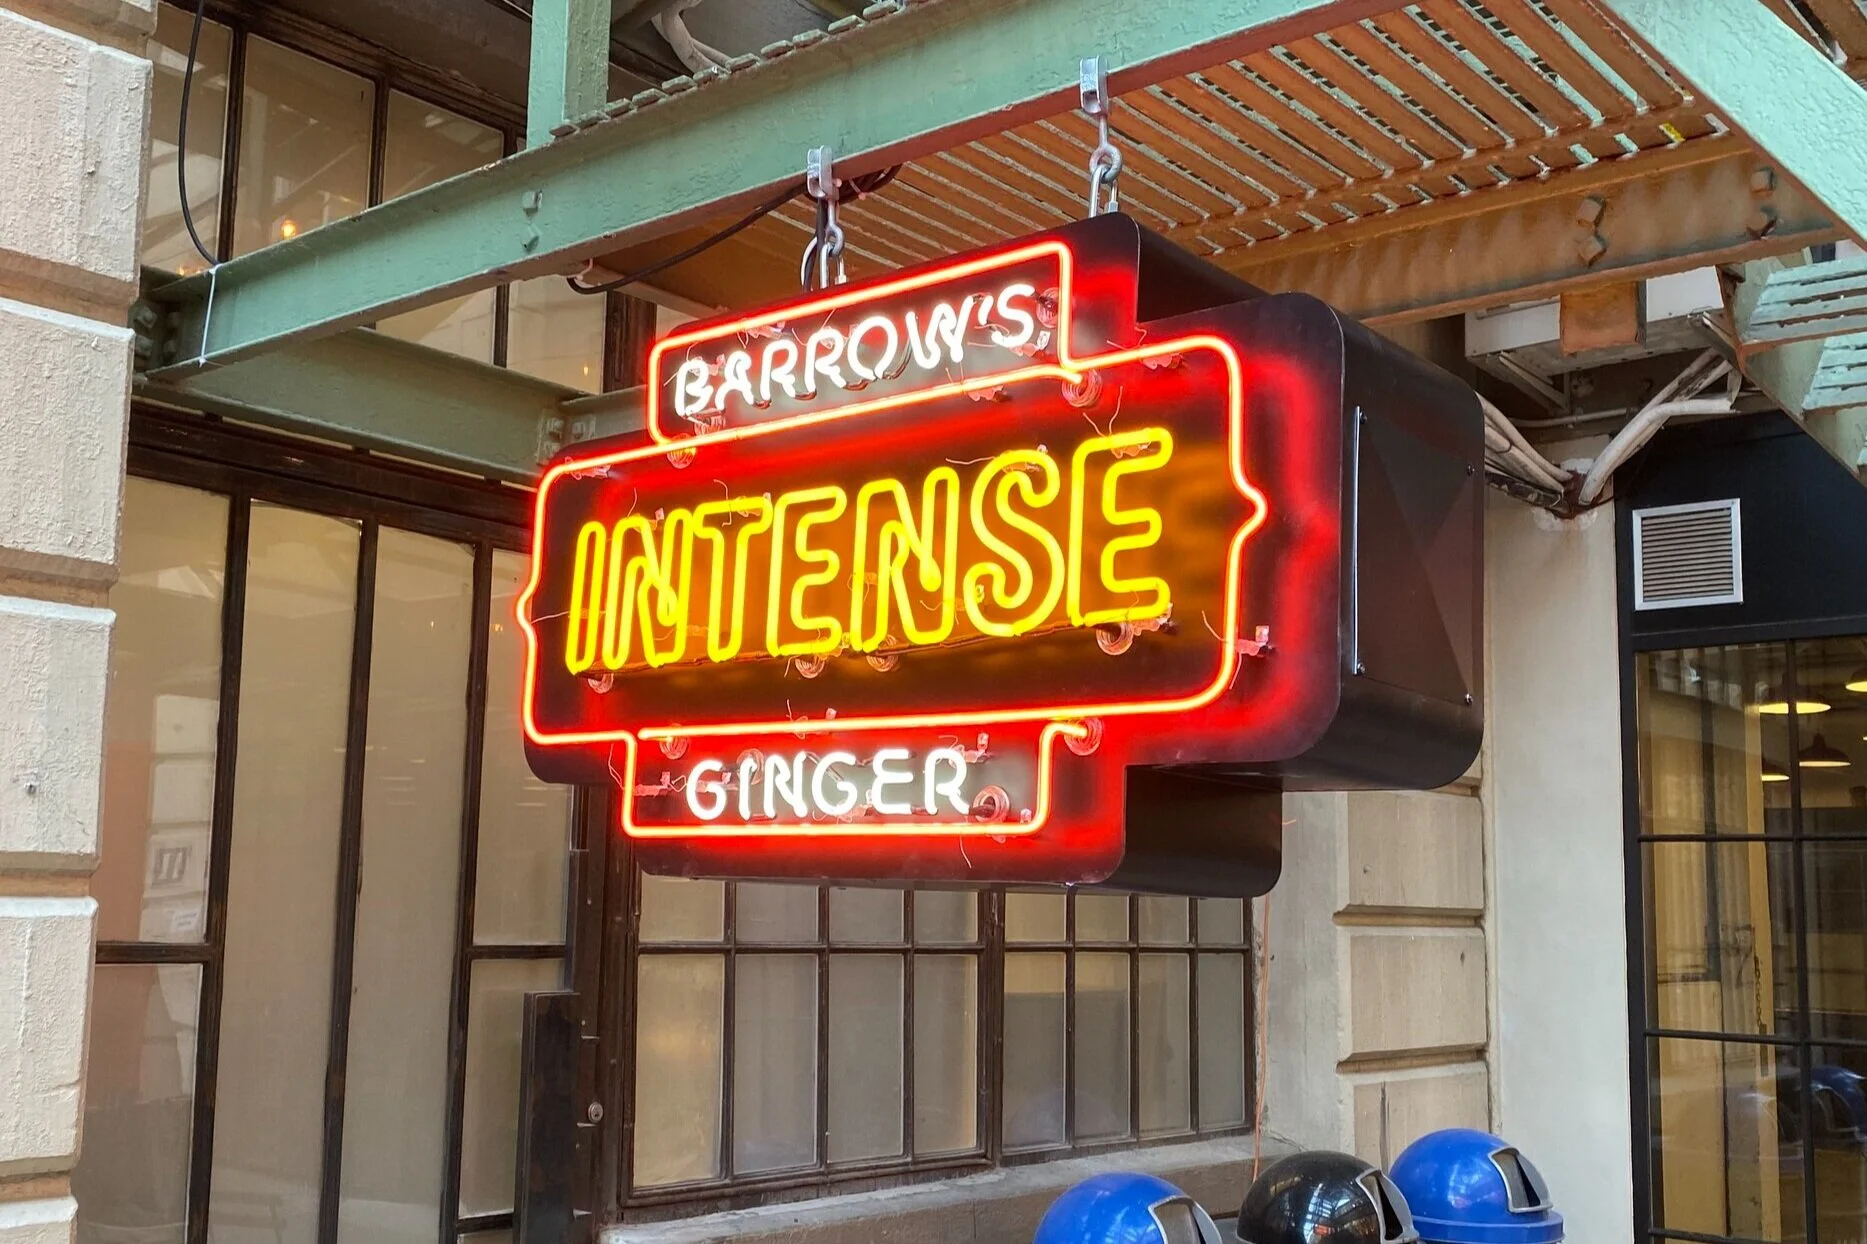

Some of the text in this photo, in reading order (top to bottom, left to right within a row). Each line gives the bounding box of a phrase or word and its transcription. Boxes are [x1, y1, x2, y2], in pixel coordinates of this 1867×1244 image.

[674, 283, 1036, 418] BARROW'S
[565, 427, 1174, 675] INTENSE
[686, 747, 970, 821] GINGER
